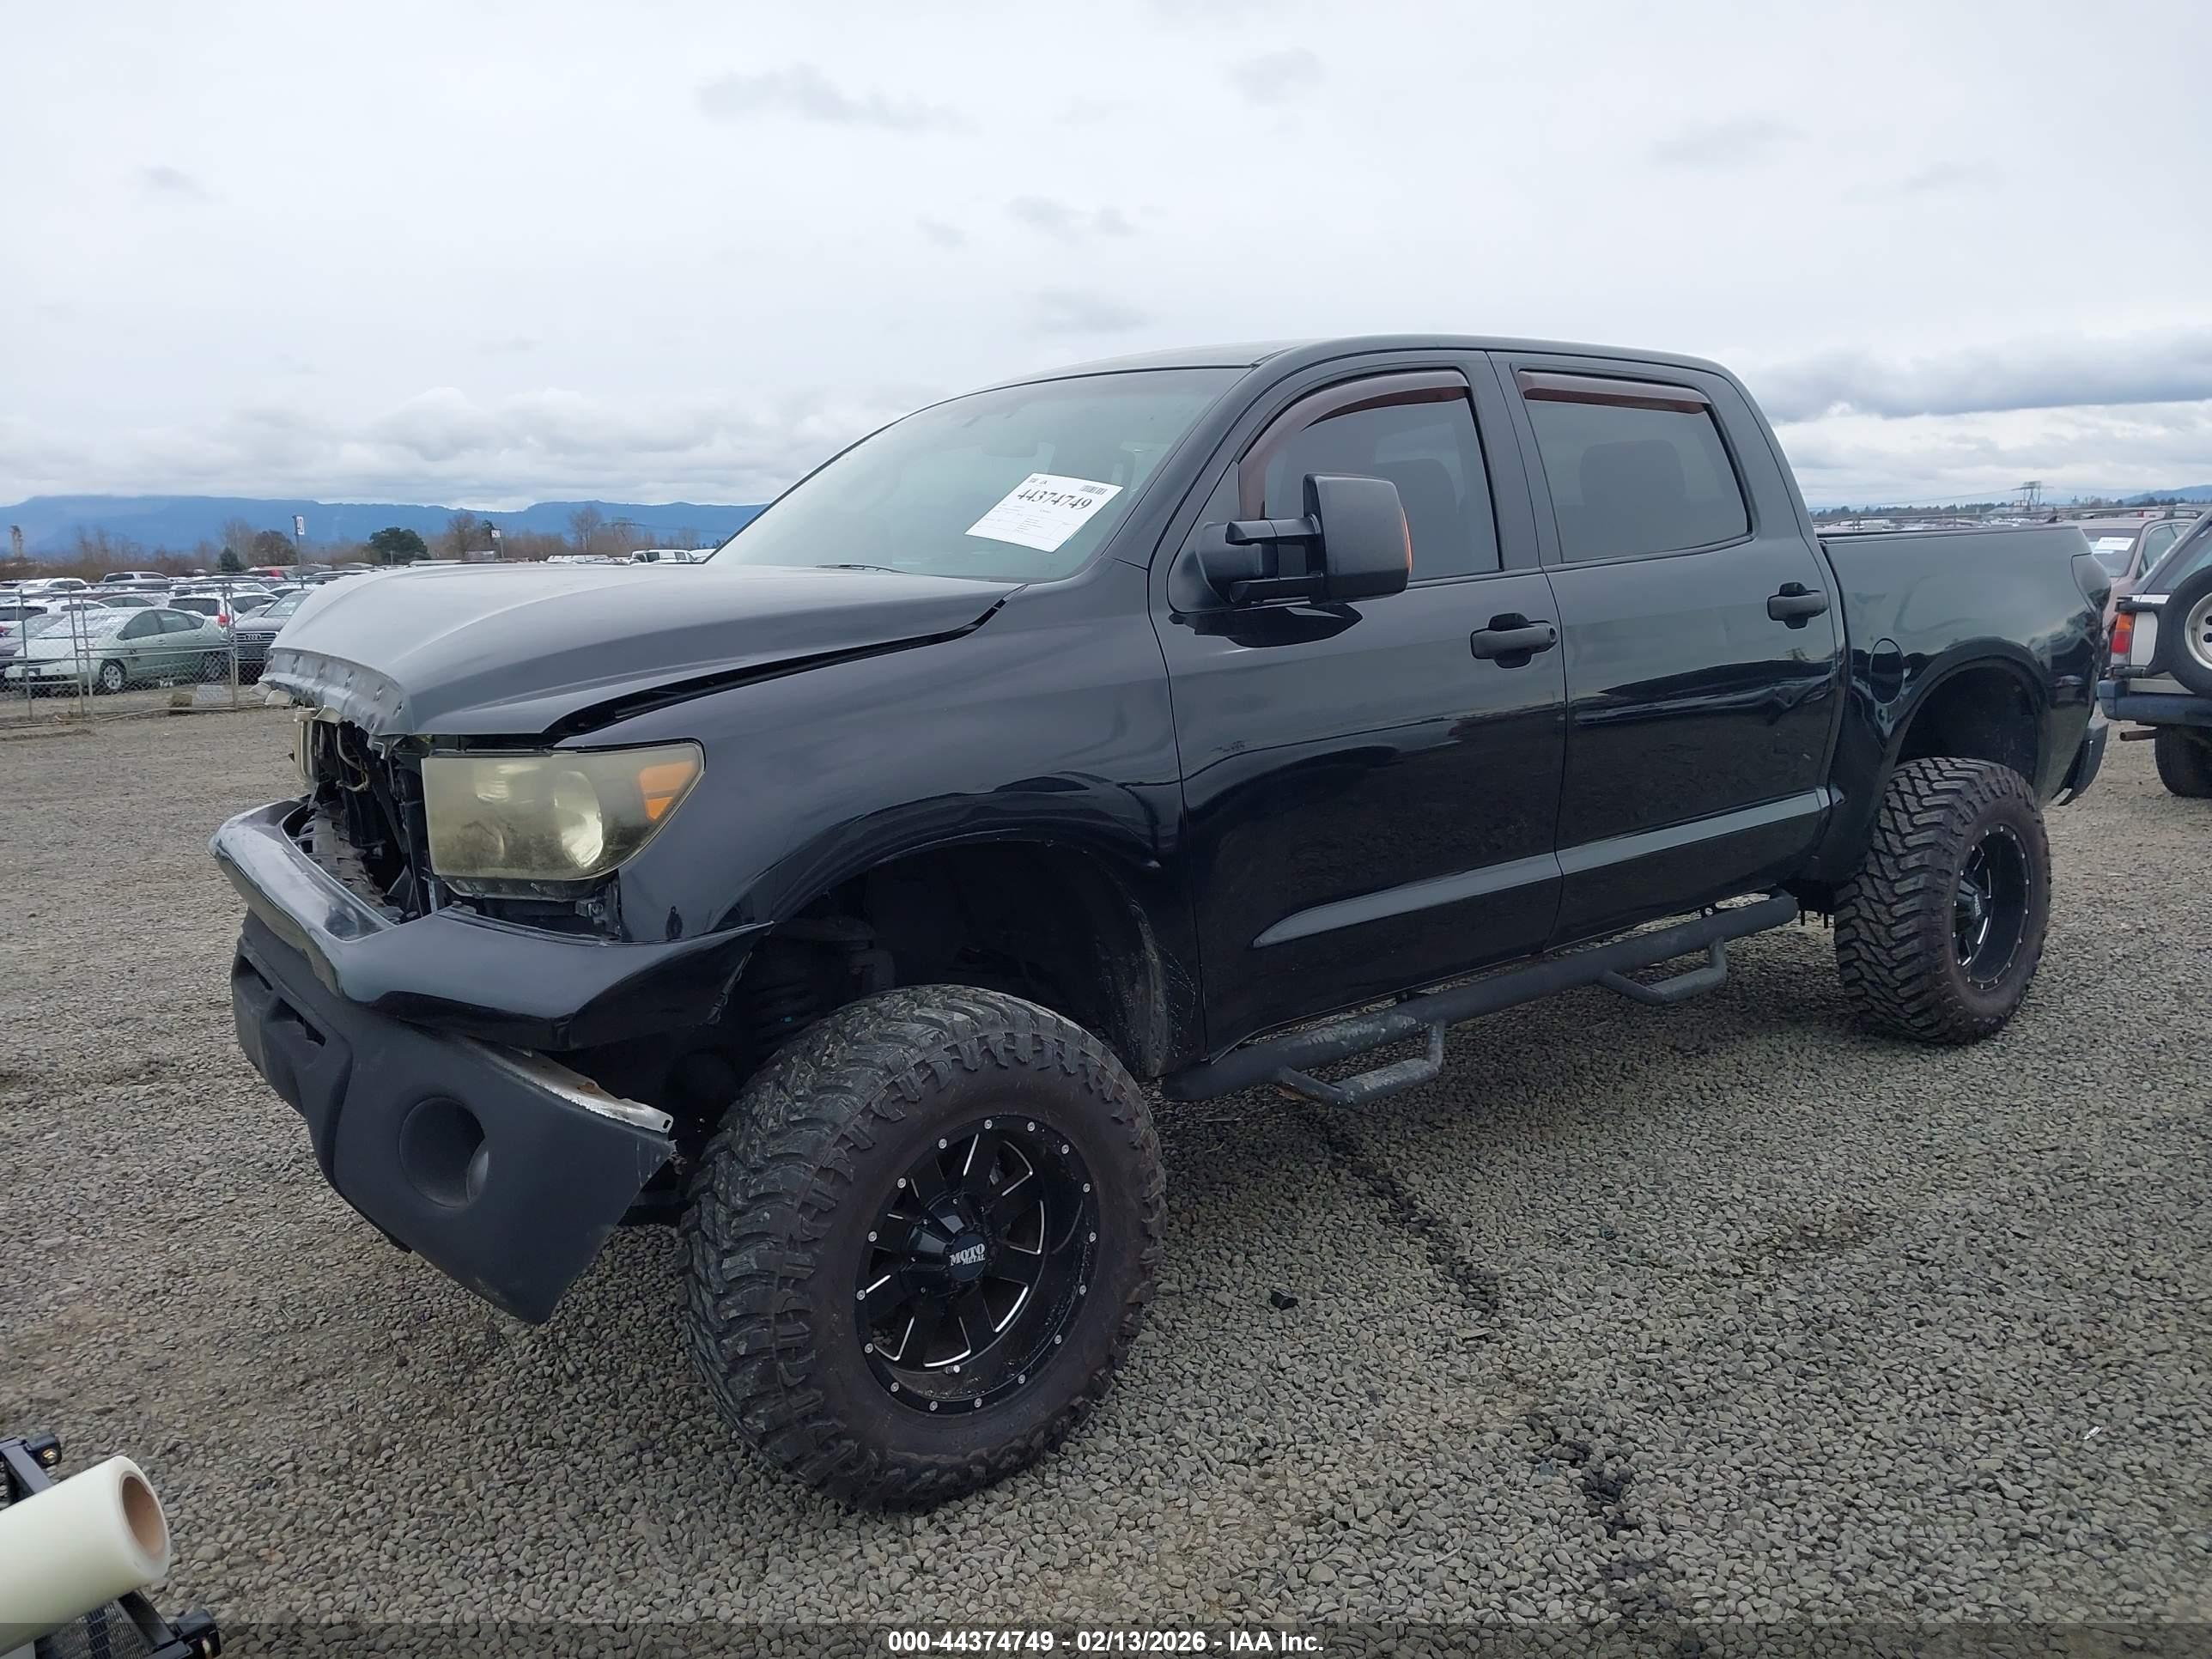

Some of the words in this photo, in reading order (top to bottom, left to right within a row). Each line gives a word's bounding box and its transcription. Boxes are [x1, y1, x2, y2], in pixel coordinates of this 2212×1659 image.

[1018, 489, 1092, 509] 44374749
[949, 1243, 985, 1266] MOTO
[963, 1254, 985, 1265] METAL
